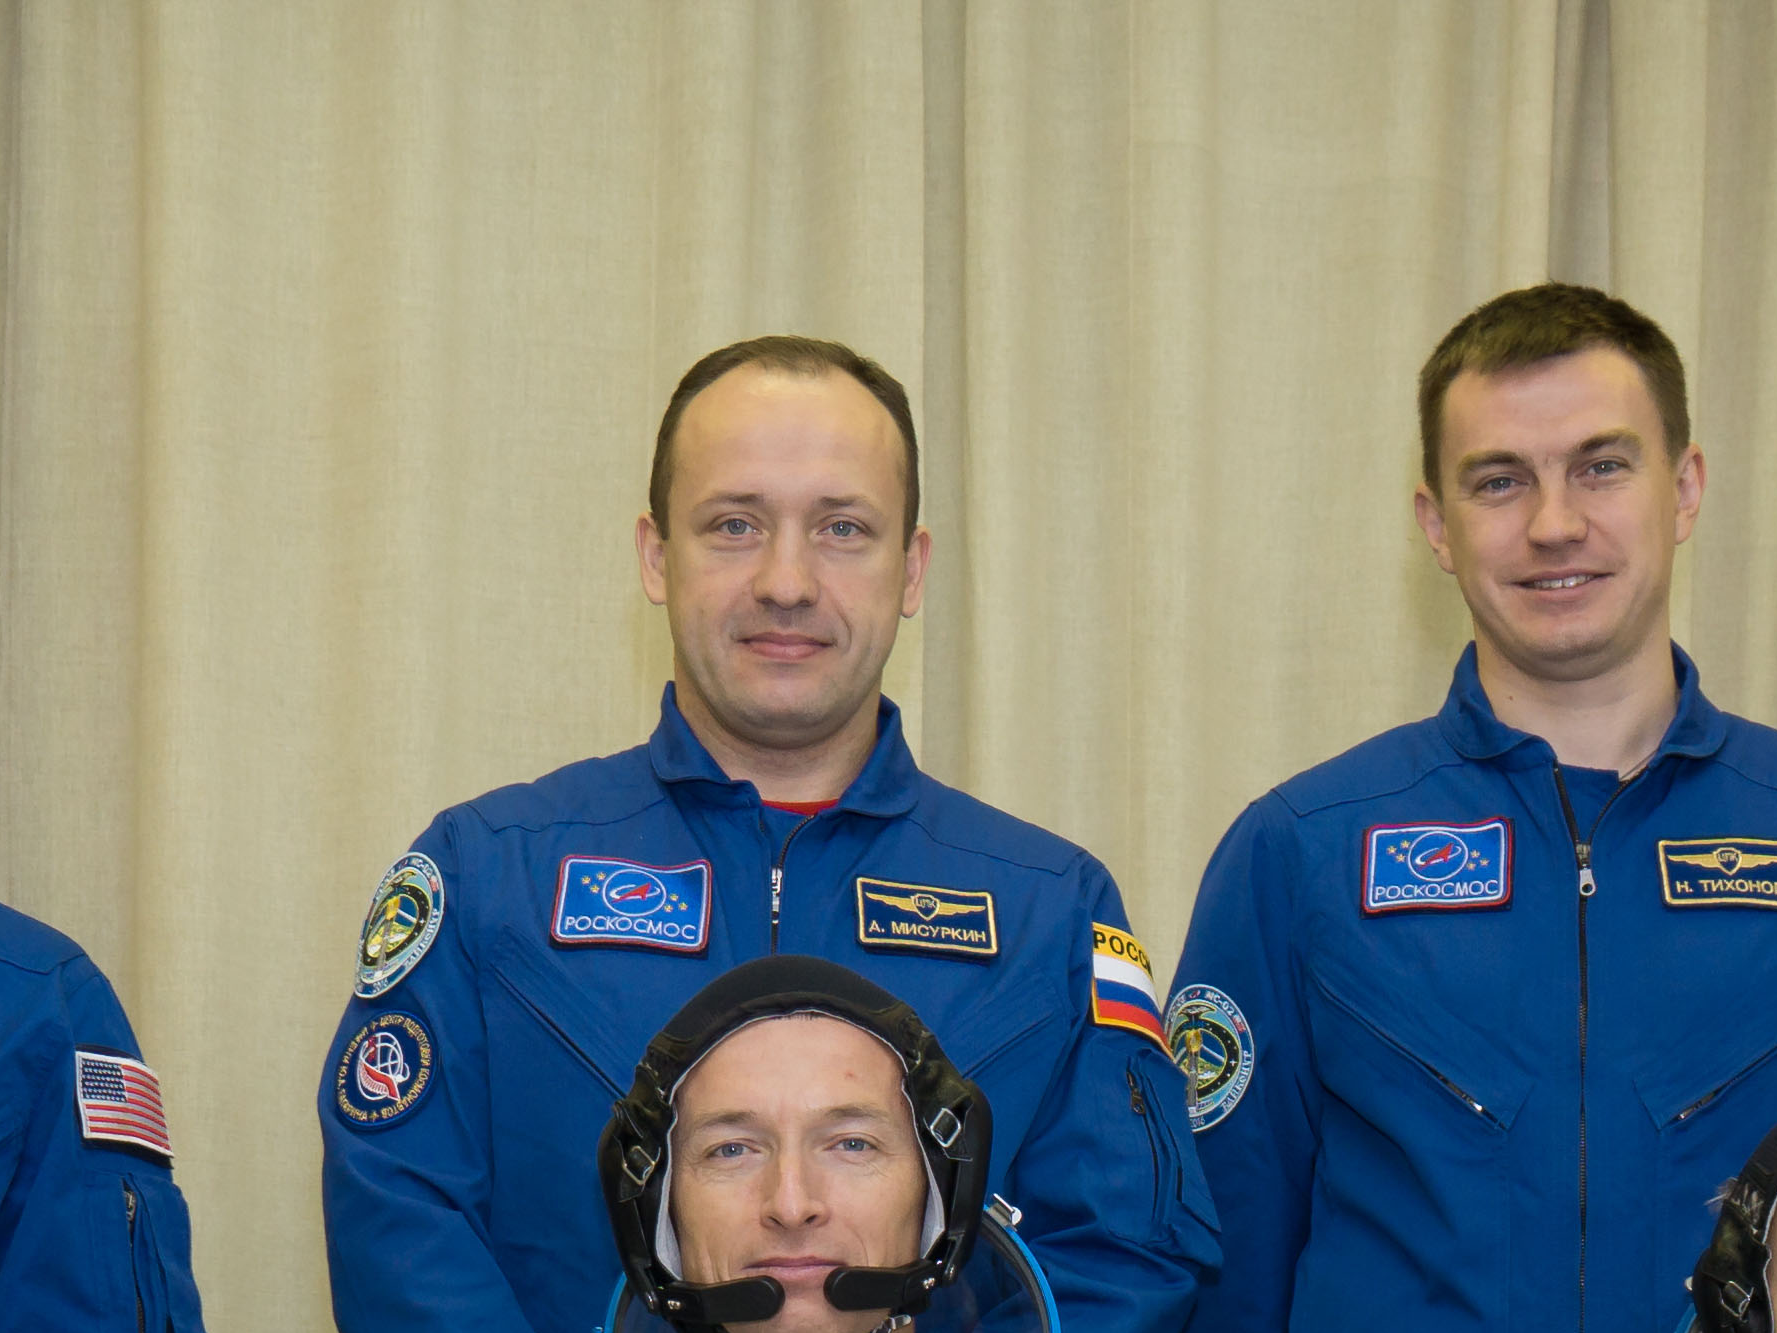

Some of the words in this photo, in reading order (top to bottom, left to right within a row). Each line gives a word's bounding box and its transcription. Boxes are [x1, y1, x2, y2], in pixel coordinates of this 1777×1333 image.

[1374, 879, 1499, 901] РОСКОСМОС
[1676, 880, 1693, 894] Н.
[564, 915, 696, 940] РОСКОСМОС
[868, 920, 885, 933] А.
[890, 921, 987, 942] МИСУРКИН
